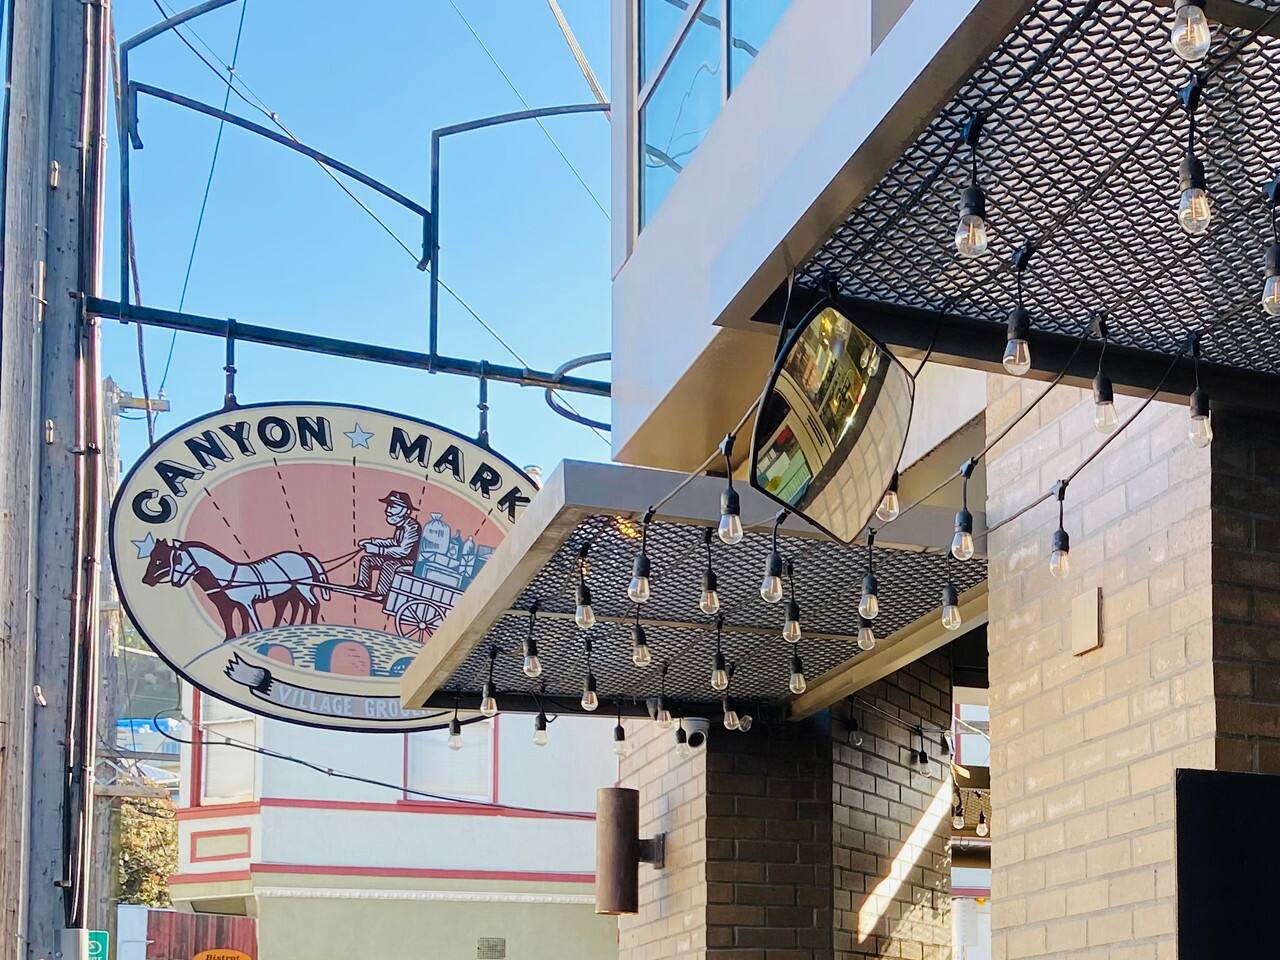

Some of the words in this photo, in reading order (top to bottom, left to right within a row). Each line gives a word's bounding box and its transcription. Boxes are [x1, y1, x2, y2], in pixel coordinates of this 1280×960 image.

[132, 416, 333, 524] CANYON
[277, 684, 353, 717] VILLAGE
[205, 953, 241, 960] Bistrot
